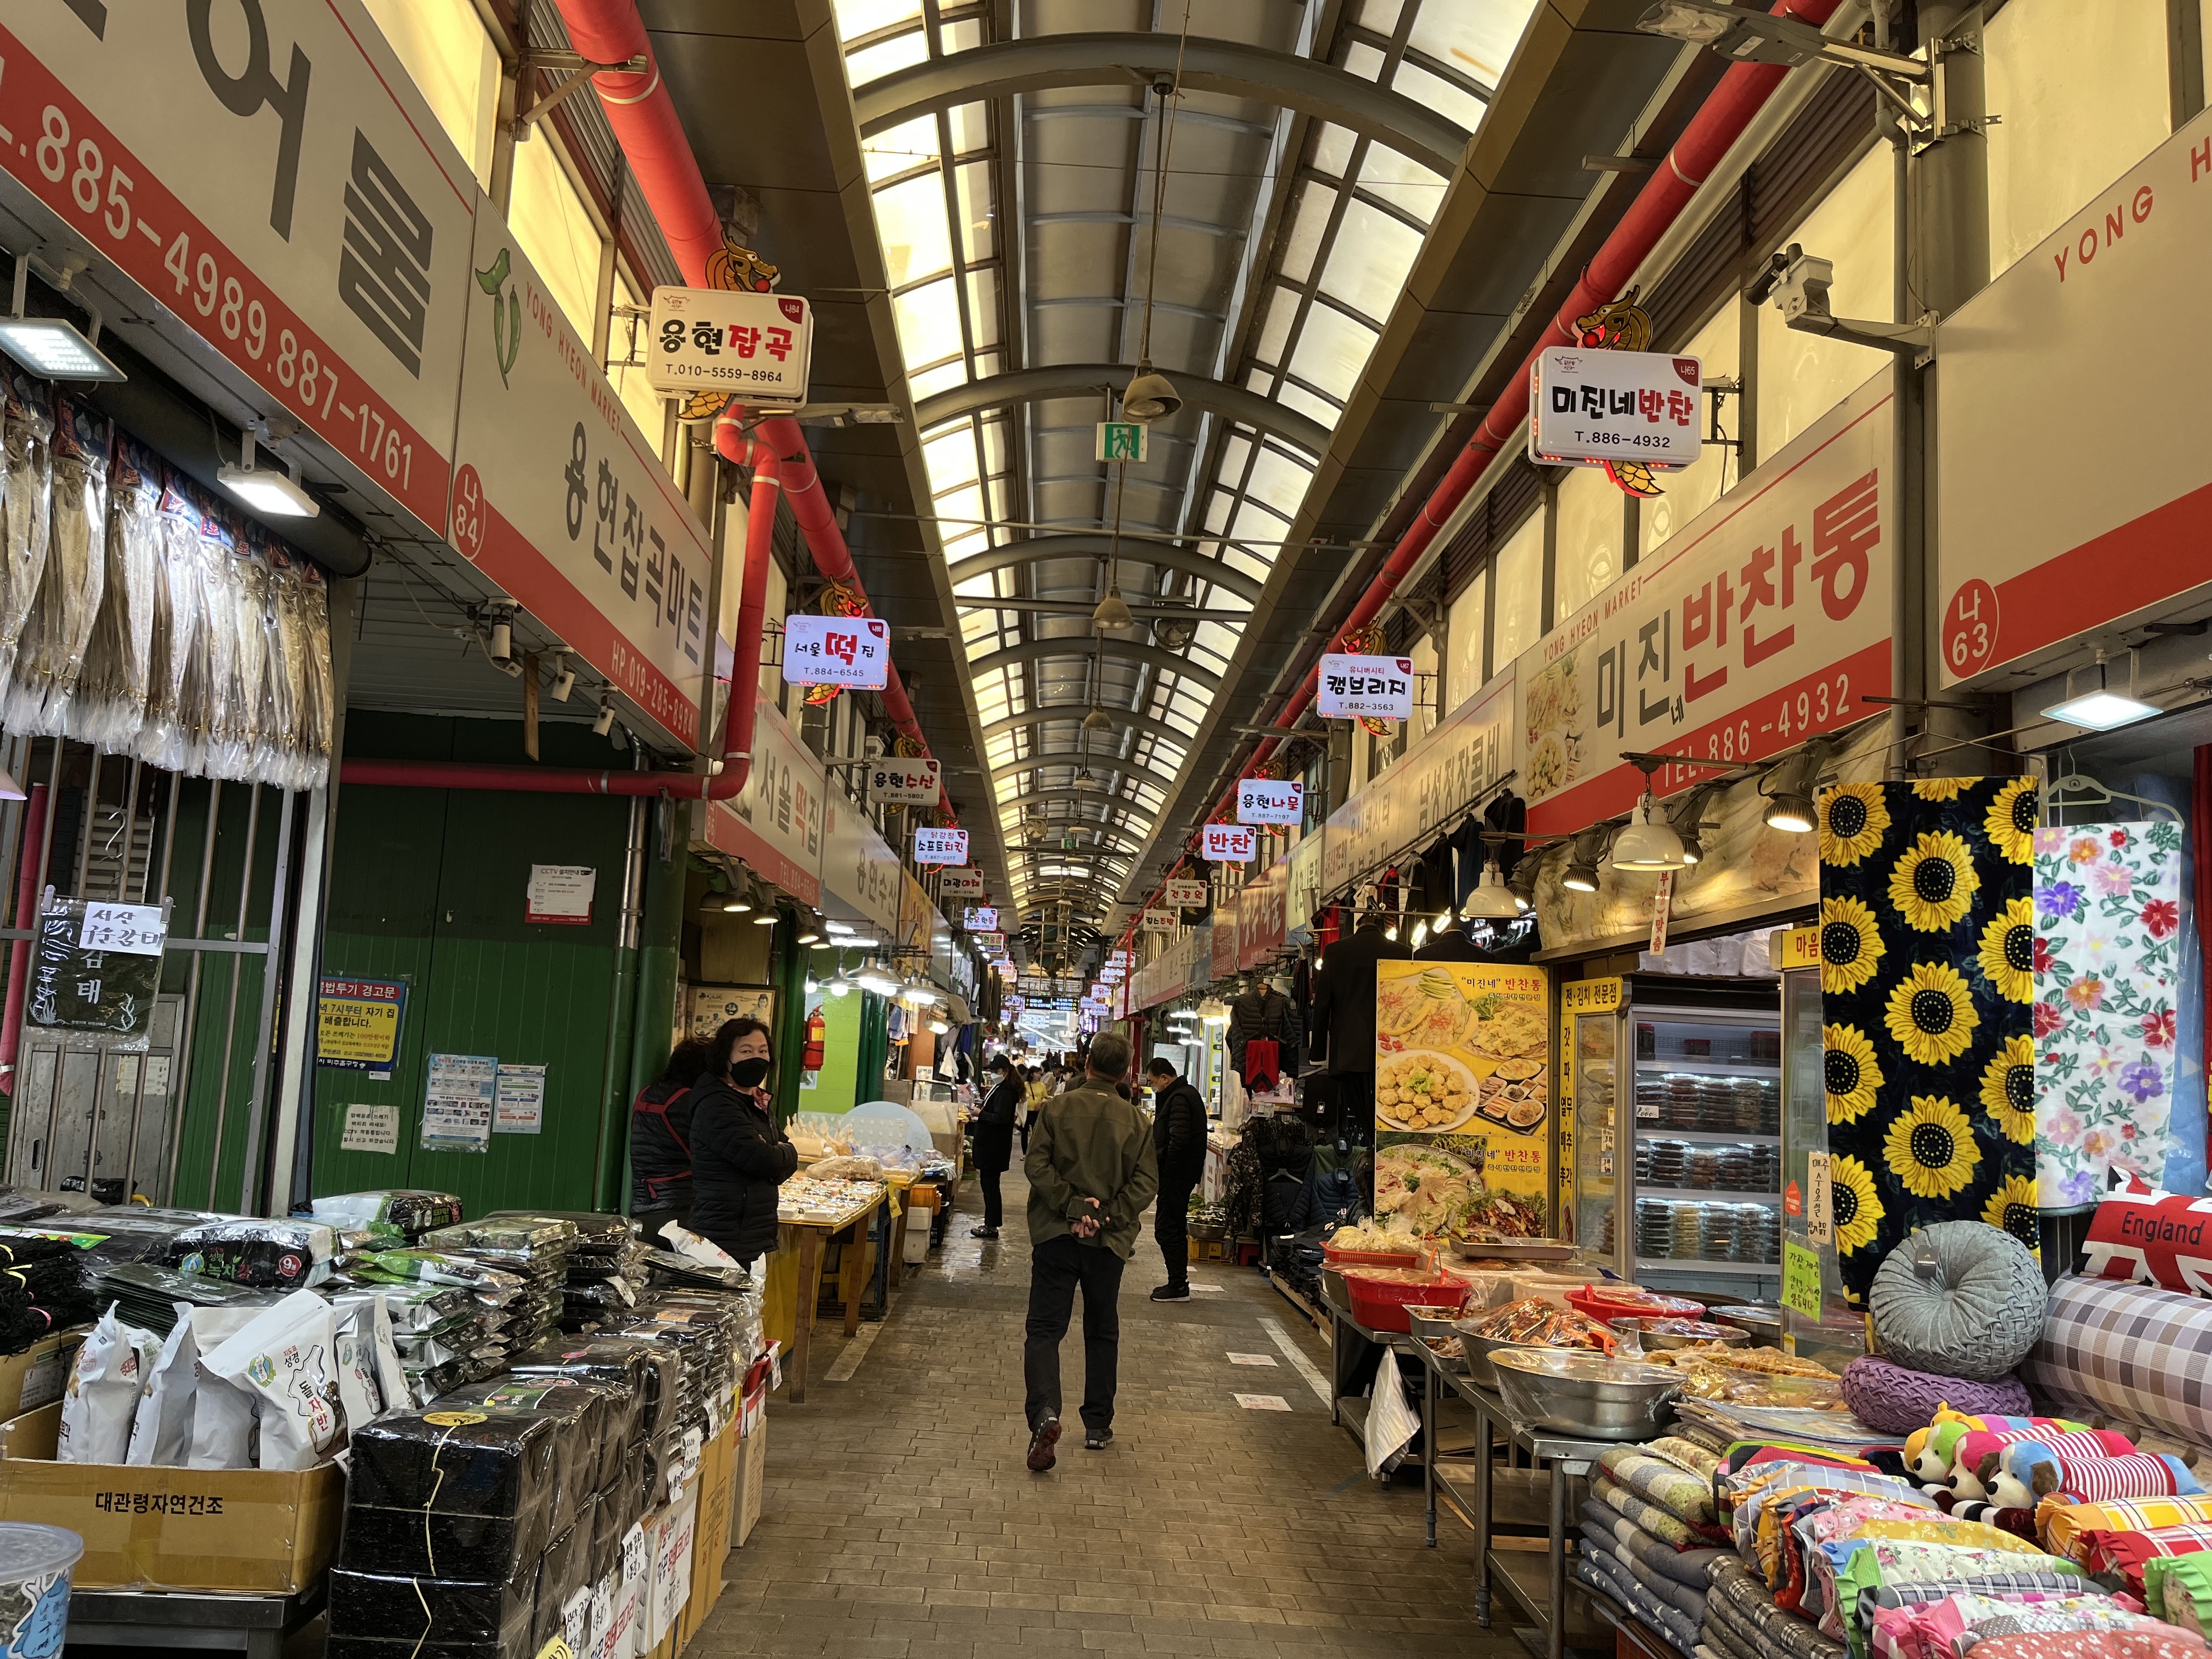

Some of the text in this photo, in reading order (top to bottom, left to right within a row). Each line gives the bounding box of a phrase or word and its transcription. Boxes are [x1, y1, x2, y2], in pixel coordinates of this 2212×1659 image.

[63, 0, 433, 381] 어물
[2055, 185, 2154, 284] YONG
[785, 304, 799, 314] 나84
[659, 319, 793, 362] 용현잡곡
[526, 280, 622, 437] YONG HYEON MARKET
[665, 364, 782, 383] T.010-5559-8964
[1680, 365, 1695, 375] 나65
[1553, 385, 1694, 426] 미진네반찬
[1575, 431, 1671, 448] T.886-4932
[464, 473, 478, 502] 나
[455, 509, 479, 549] 84
[565, 421, 702, 665] 용현잡곡마트
[1958, 588, 1981, 620] 나
[1544, 576, 1643, 664] YONG HYEON MARKET
[1952, 622, 1989, 667] 63
[804, 667, 864, 676] T.884-6545
[1349, 666, 1385, 675] 유니버시티
[1327, 675, 1406, 695] 캠브리지
[1339, 702, 1394, 710] T.882-3563
[874, 772, 935, 789] 용현수산
[760, 747, 820, 857] 서울떡집
[1243, 794, 1299, 811] 용현나물
[1351, 792, 1391, 850] 유니버시티
[930, 831, 955, 840] 닭강정
[1209, 833, 1251, 854] 반찬
[918, 840, 963, 853] 소프트치킨
[857, 847, 897, 918] 용현수산
[1171, 890, 1203, 900] 건강원
[92, 910, 136, 924] 서산
[1796, 932, 1819, 958] 마음
[362, 984, 396, 998] 경고문
[1505, 978, 1542, 991] 반찬통
[1594, 983, 1617, 1005] 전문점
[331, 1004, 362, 1016] 7시부터
[366, 1007, 383, 1018] 자기
[387, 1008, 395, 1019] 집
[324, 1016, 371, 1028] 배출합니다.
[1505, 1149, 1542, 1164] 반찬통
[1812, 1158, 1830, 1171] 매주
[2121, 1210, 2205, 1246] England
[283, 1345, 298, 1357] 지도표
[284, 1351, 300, 1368] 성경
[298, 1380, 329, 1432] 돌자반
[94, 1492, 224, 1516] 대관령자연건조
